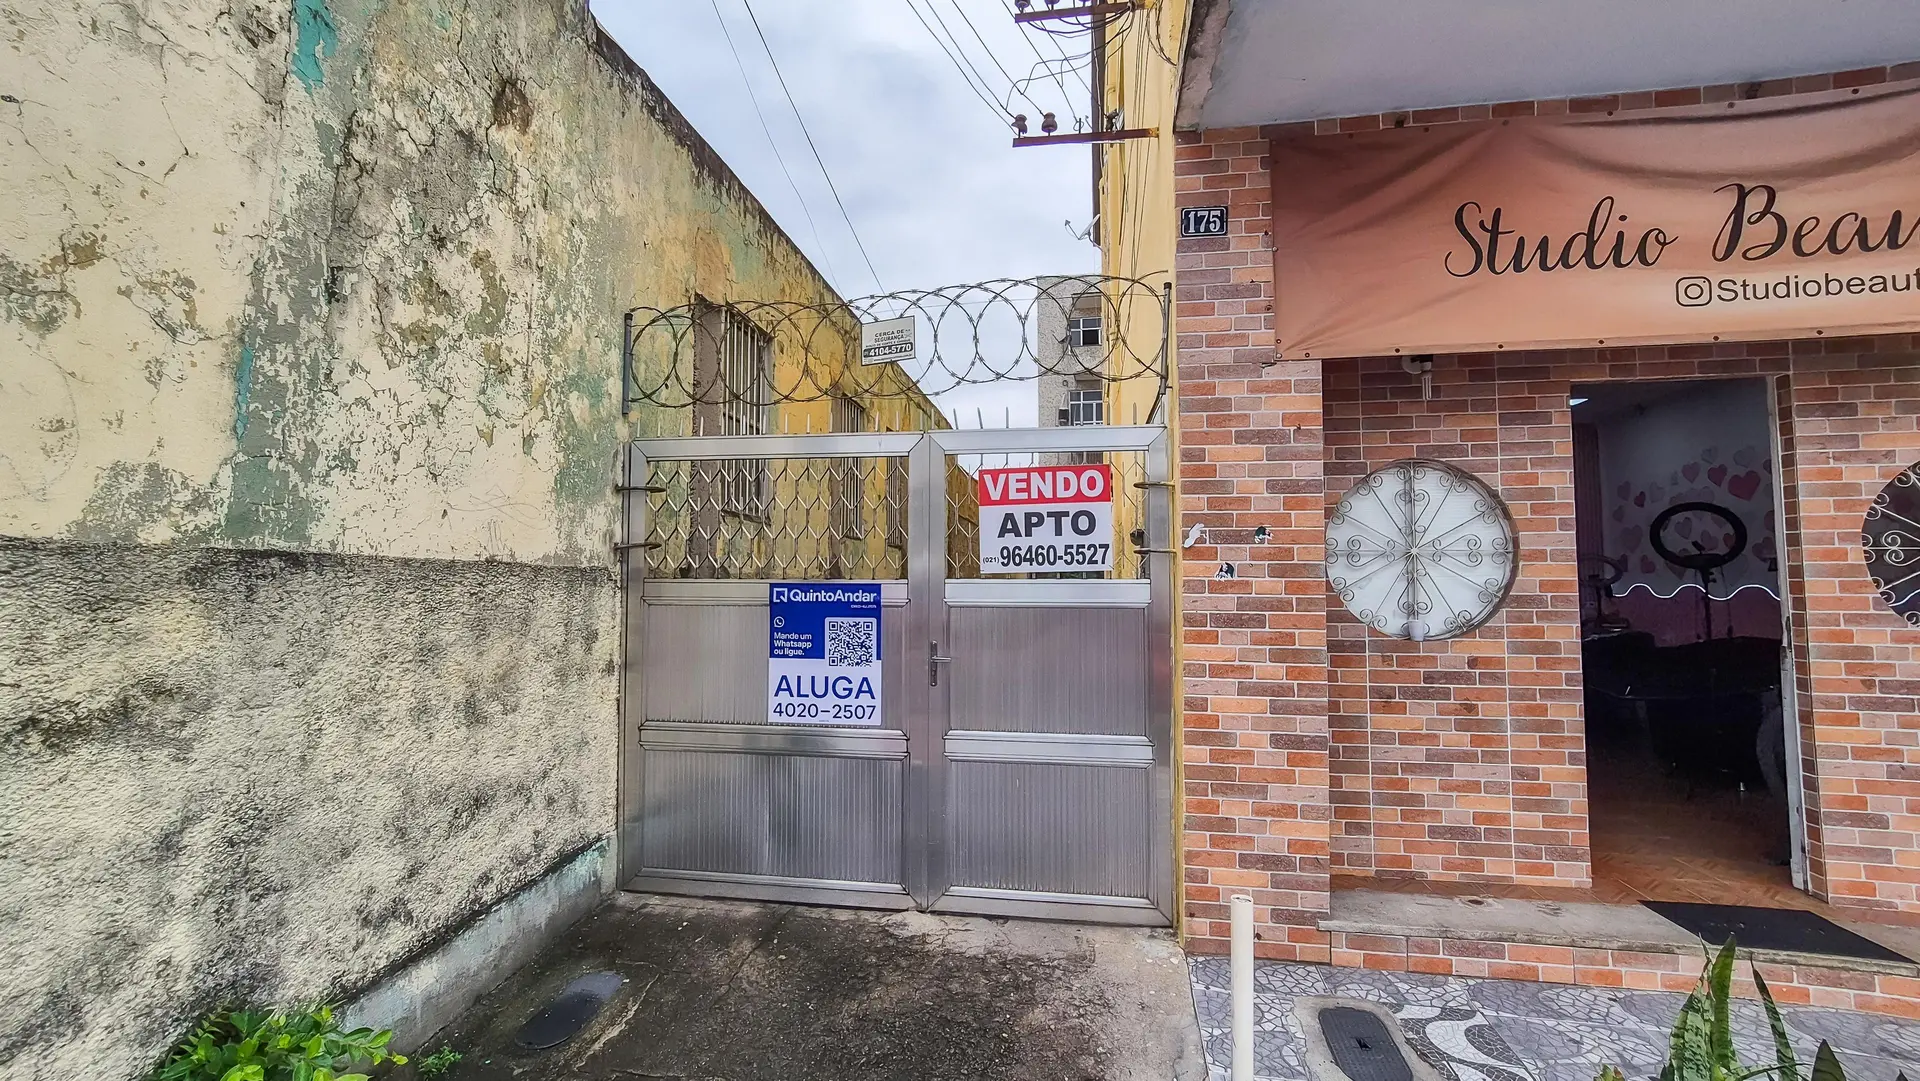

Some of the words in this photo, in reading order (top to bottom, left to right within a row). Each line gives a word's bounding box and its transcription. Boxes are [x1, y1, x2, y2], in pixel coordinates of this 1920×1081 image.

[1188, 210, 1221, 233] 175
[1445, 195, 1679, 278] Studio
[870, 344, 911, 356] 4104-5770
[982, 469, 1105, 501] VENDO
[997, 509, 1097, 539] APTO
[982, 556, 1000, 564] (021)
[999, 543, 1110, 568] 96460-5527
[789, 589, 878, 603] QuintoAndar
[774, 632, 798, 640] Mande
[774, 640, 812, 649] Whatsapp
[784, 648, 805, 657] ligue.
[773, 674, 877, 700] ALUGA
[772, 702, 877, 720] 4020-2507
